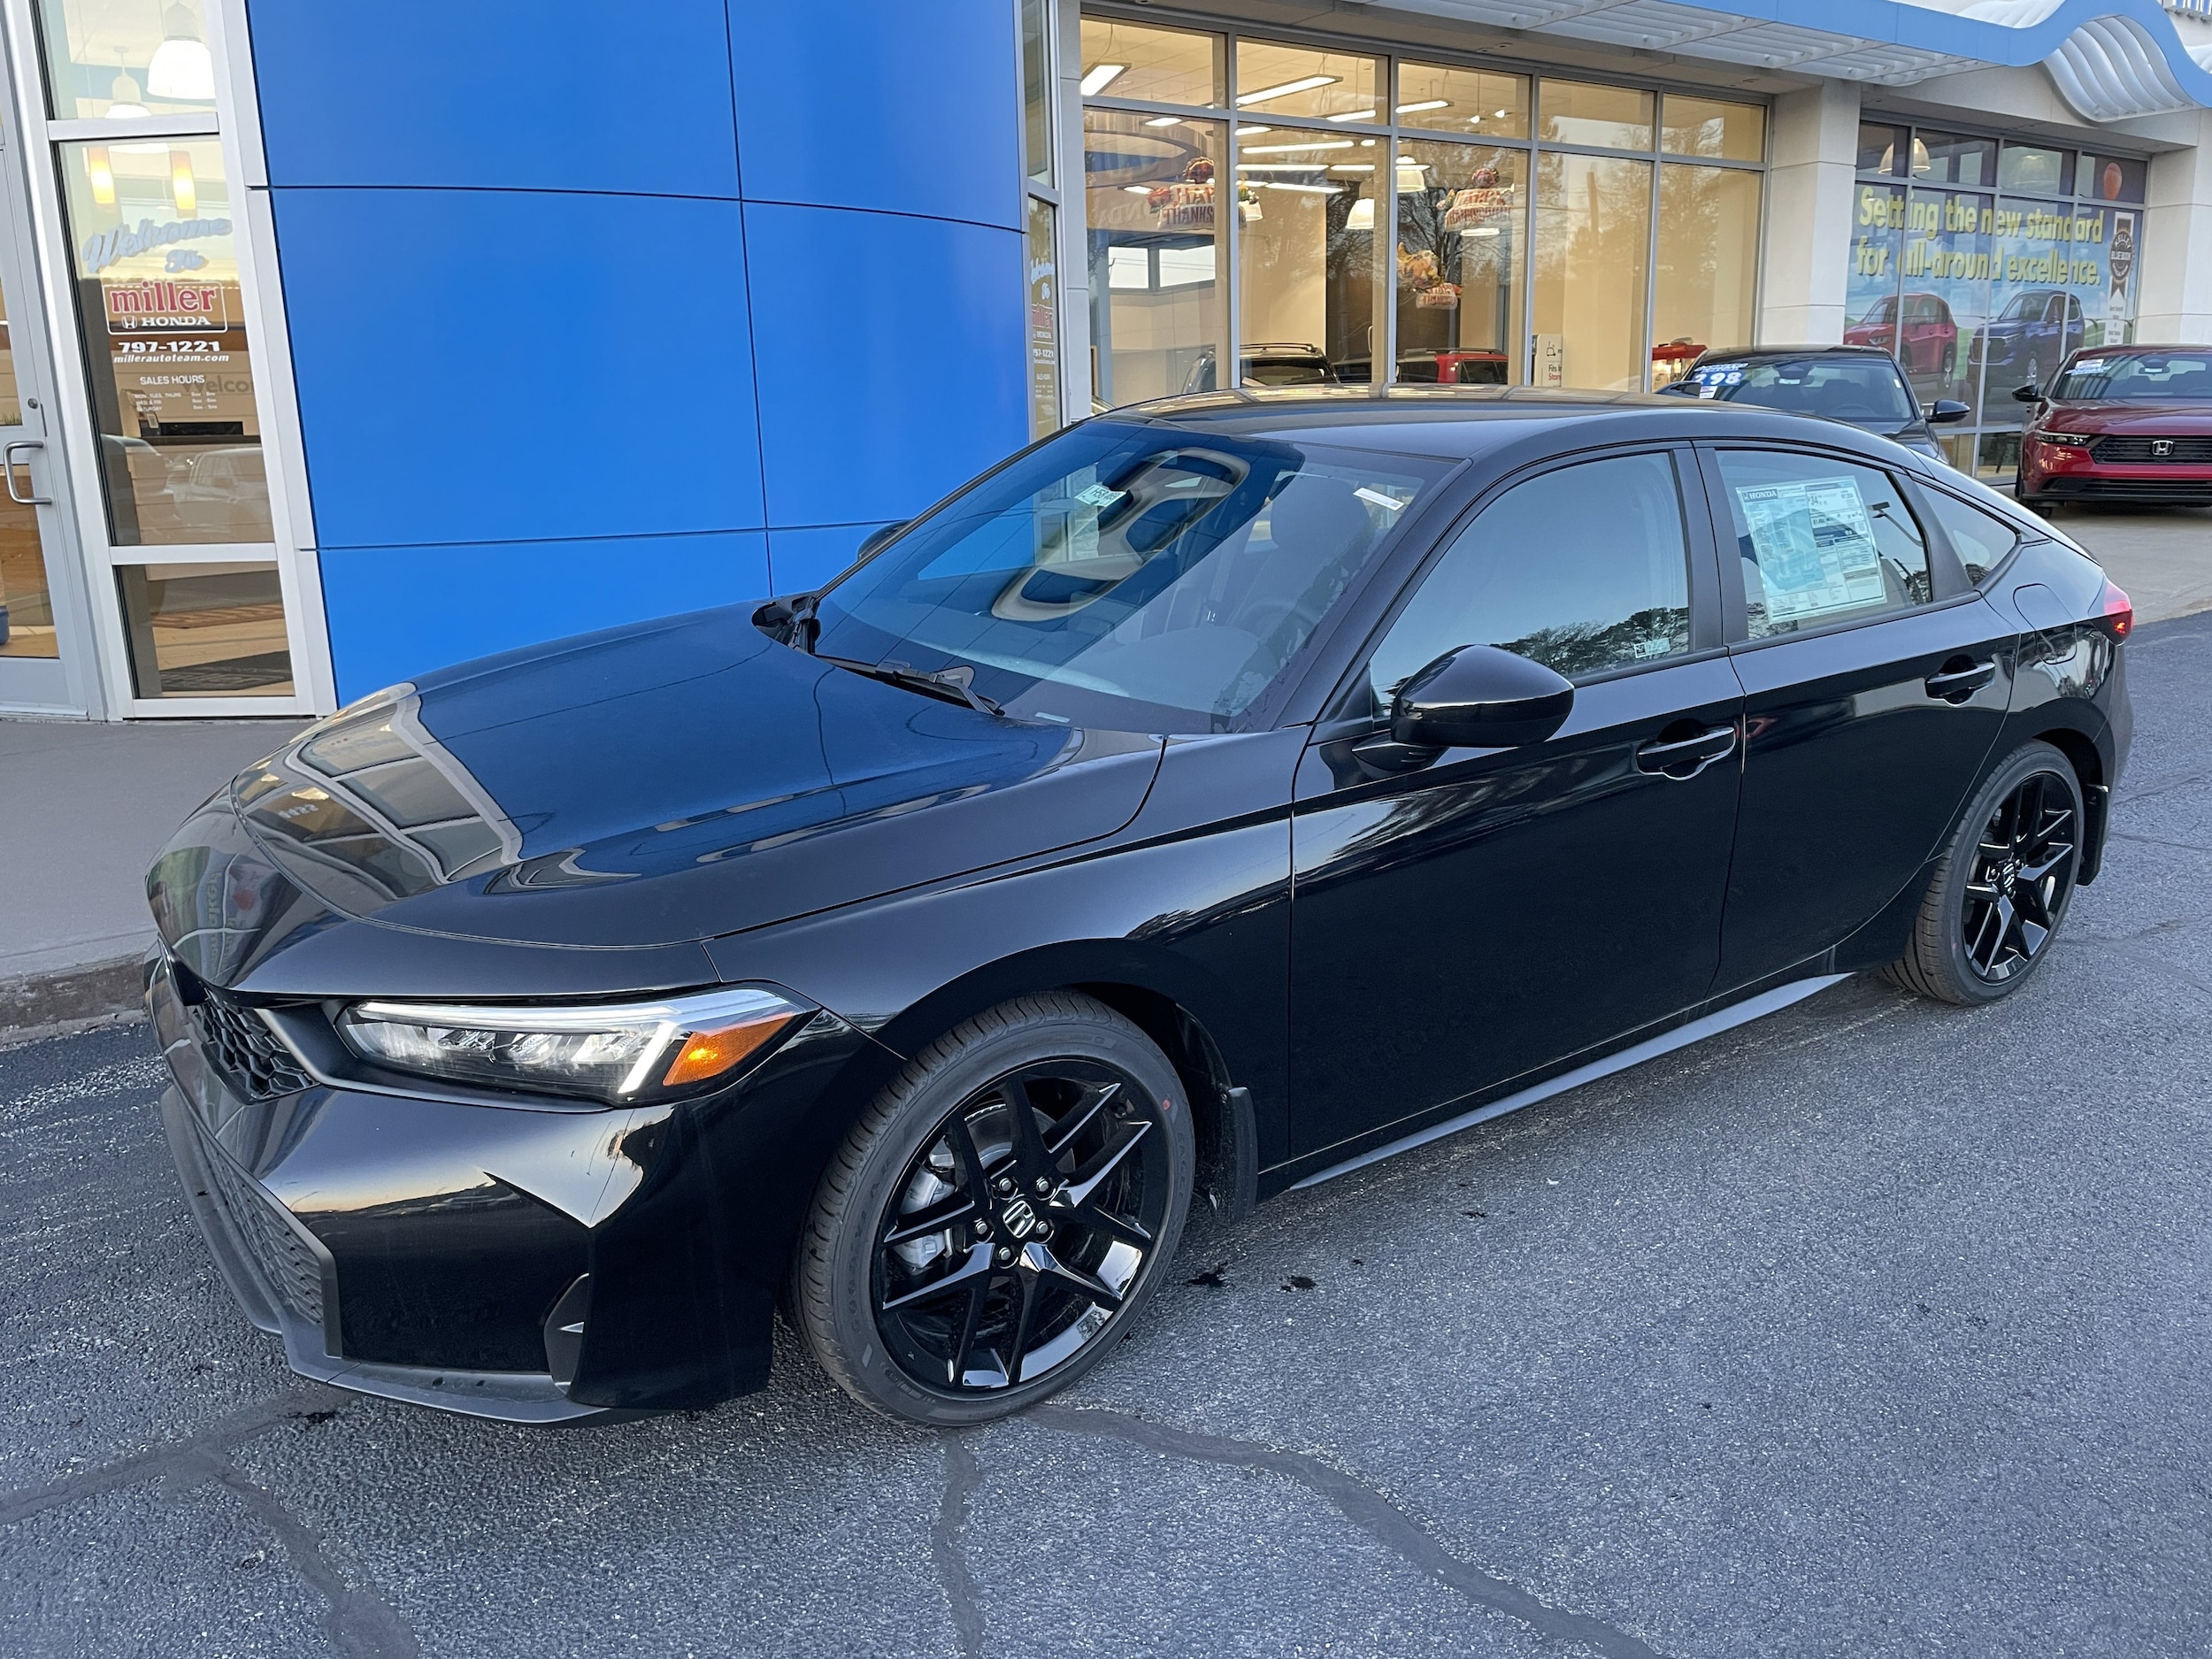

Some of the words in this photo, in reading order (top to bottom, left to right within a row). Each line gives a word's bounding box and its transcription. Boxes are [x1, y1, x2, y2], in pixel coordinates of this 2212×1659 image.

[1176, 187, 1215, 205] HAP
[1859, 186, 1939, 241] Setting
[1946, 194, 1978, 233] the
[1981, 208, 2022, 238] new
[1856, 235, 1890, 276] for
[111, 280, 216, 313] miller
[141, 316, 211, 327] HONDA
[118, 341, 220, 353] 797-1221
[113, 354, 229, 364] millerautoteam.com
[140, 375, 170, 385] SALES
[171, 374, 205, 384] HOURS
[180, 374, 250, 393] Welco
[1748, 489, 1778, 501] HONDA
